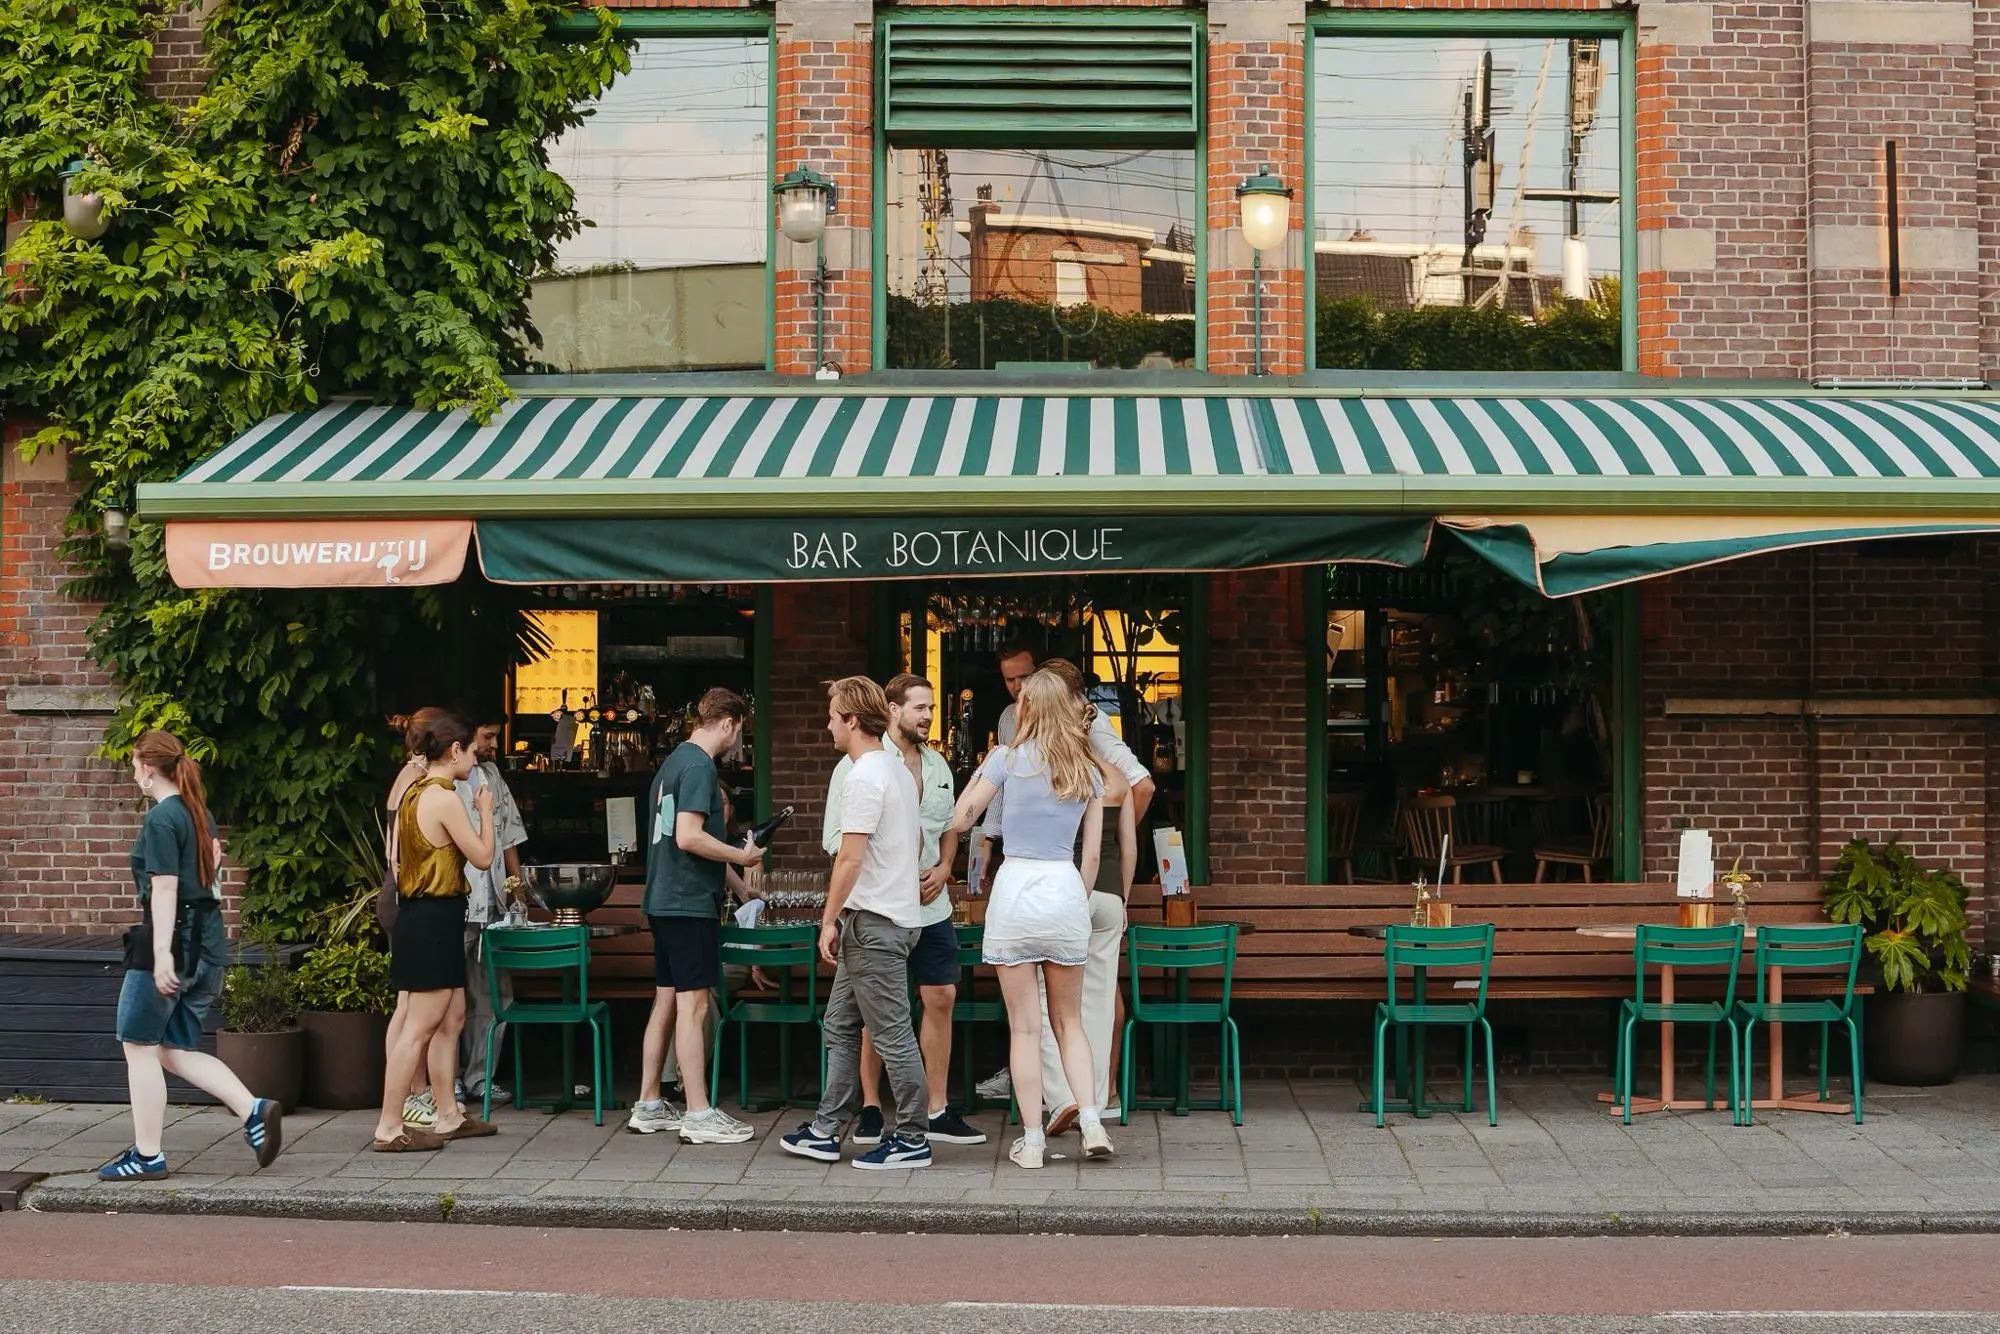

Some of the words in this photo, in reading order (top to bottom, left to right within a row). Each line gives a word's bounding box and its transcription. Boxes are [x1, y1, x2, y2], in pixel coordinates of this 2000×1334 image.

[208, 541, 377, 570] BROUWERIJ
[786, 532, 862, 569] BAR
[886, 528, 1123, 567] BOTANIQUE
